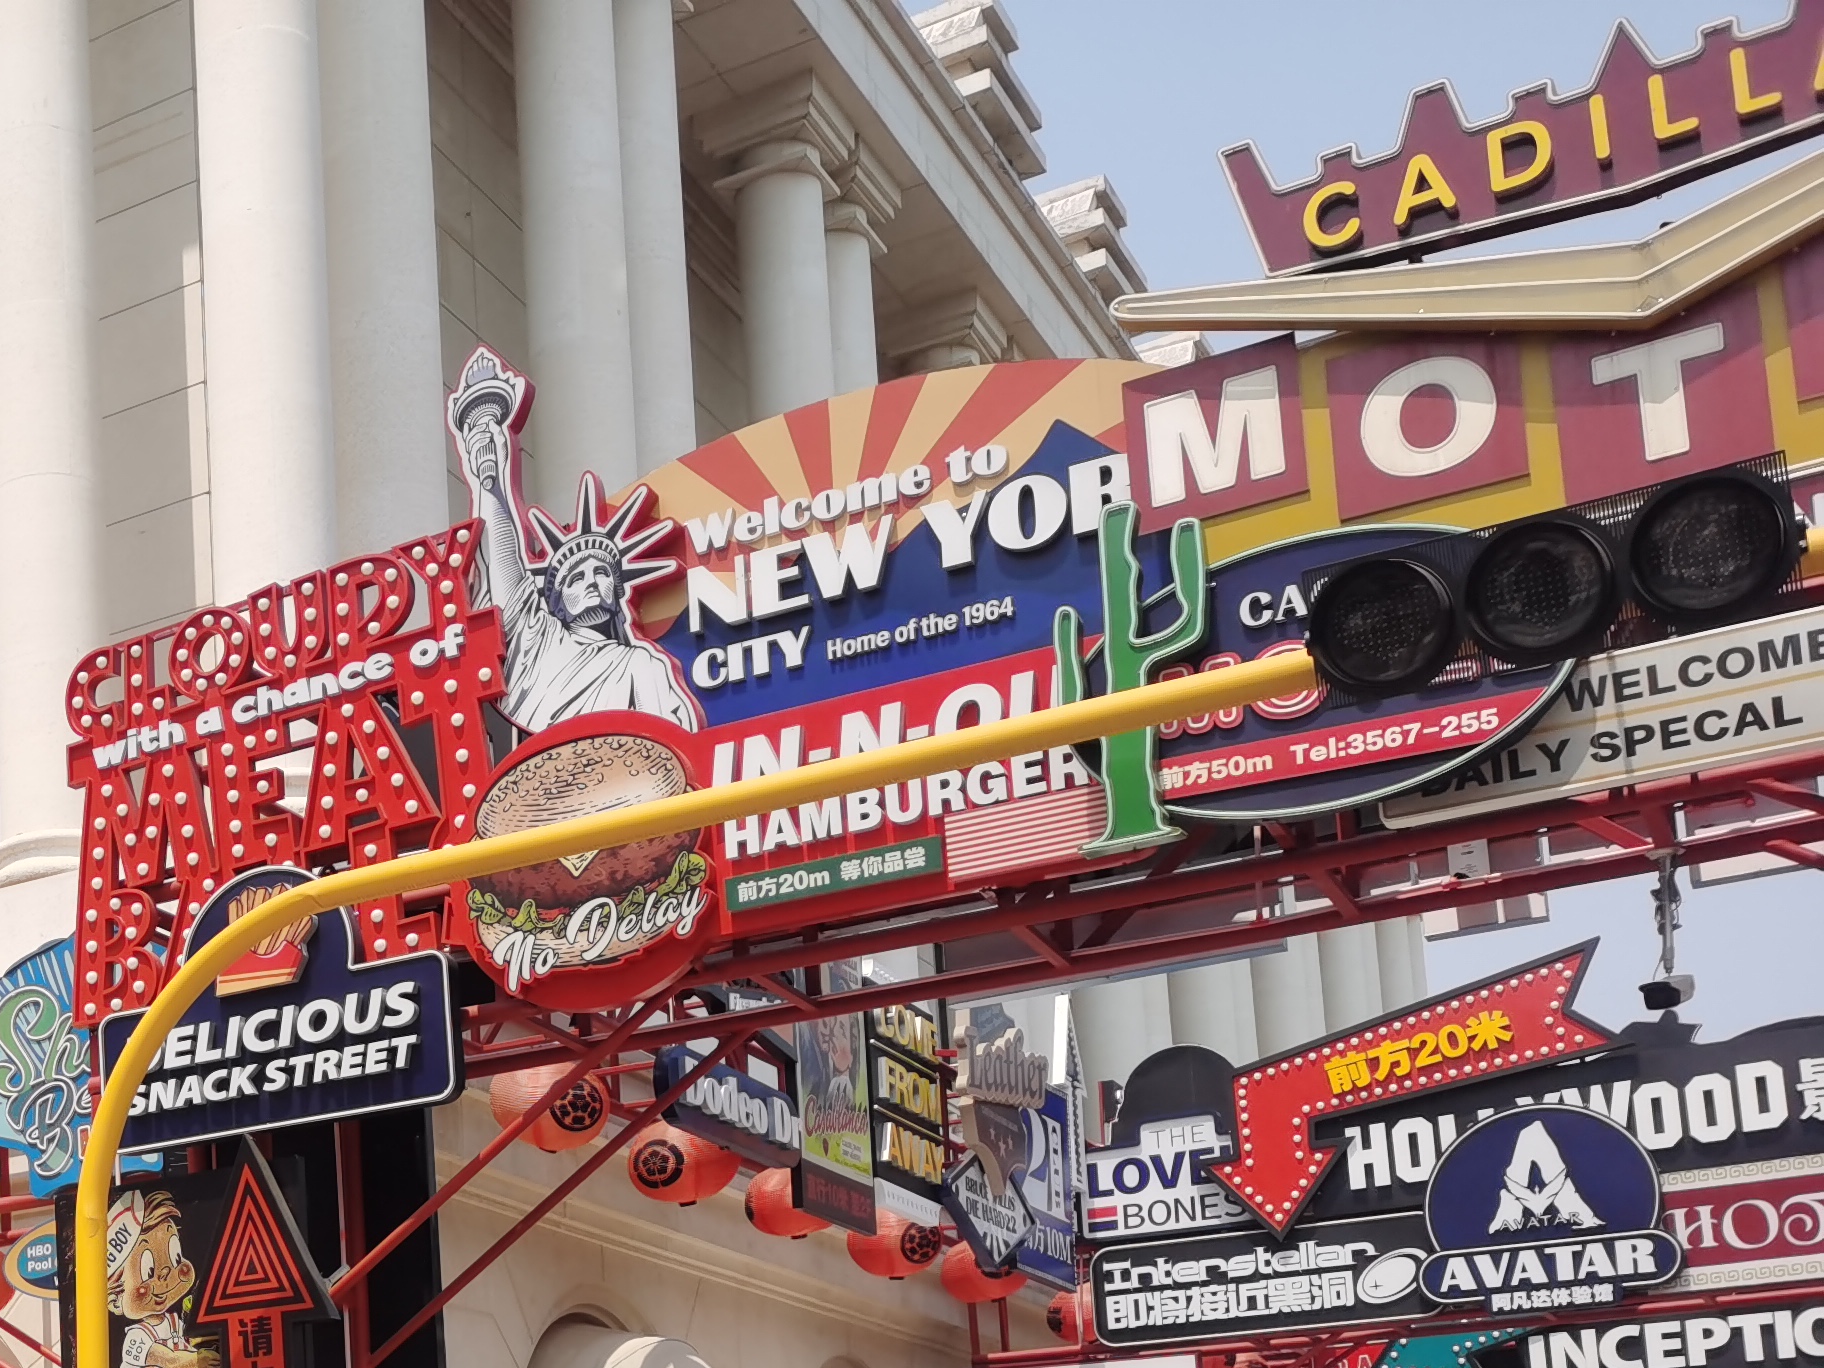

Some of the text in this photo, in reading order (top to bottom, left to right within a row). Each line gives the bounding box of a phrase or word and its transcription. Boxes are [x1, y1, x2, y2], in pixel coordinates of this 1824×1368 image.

[1302, 43, 1824, 250] CADILL
[686, 443, 1009, 556] Welcome to
[687, 514, 894, 634] NEW
[66, 518, 484, 738] CLOUDY
[692, 596, 1015, 690] CITY Home of the 1964
[92, 624, 466, 770] with a chance of
[1290, 707, 1500, 767] Tel:3567-255
[1420, 696, 1804, 801] AILY SPECAL
[736, 845, 927, 903] 前方20m 等你品尝
[565, 887, 707, 961] Delay
[130, 1035, 419, 1118] SNACK STREET
[968, 1028, 1049, 1102] Leather
[1324, 1010, 1514, 1093] 前方20米
[884, 1056, 942, 1125] FROM
[888, 1122, 944, 1185] AWAY
[1149, 1123, 1206, 1150] THE
[26, 1243, 52, 1259] HBO
[27, 1260, 52, 1273] Pool
[1103, 1240, 1380, 1292] Interstellar
[1440, 1238, 1658, 1293] AVATAR
[1105, 1270, 1355, 1330] 即将接近黑洞
[1491, 1282, 1614, 1312] 阿凡达体验馆
